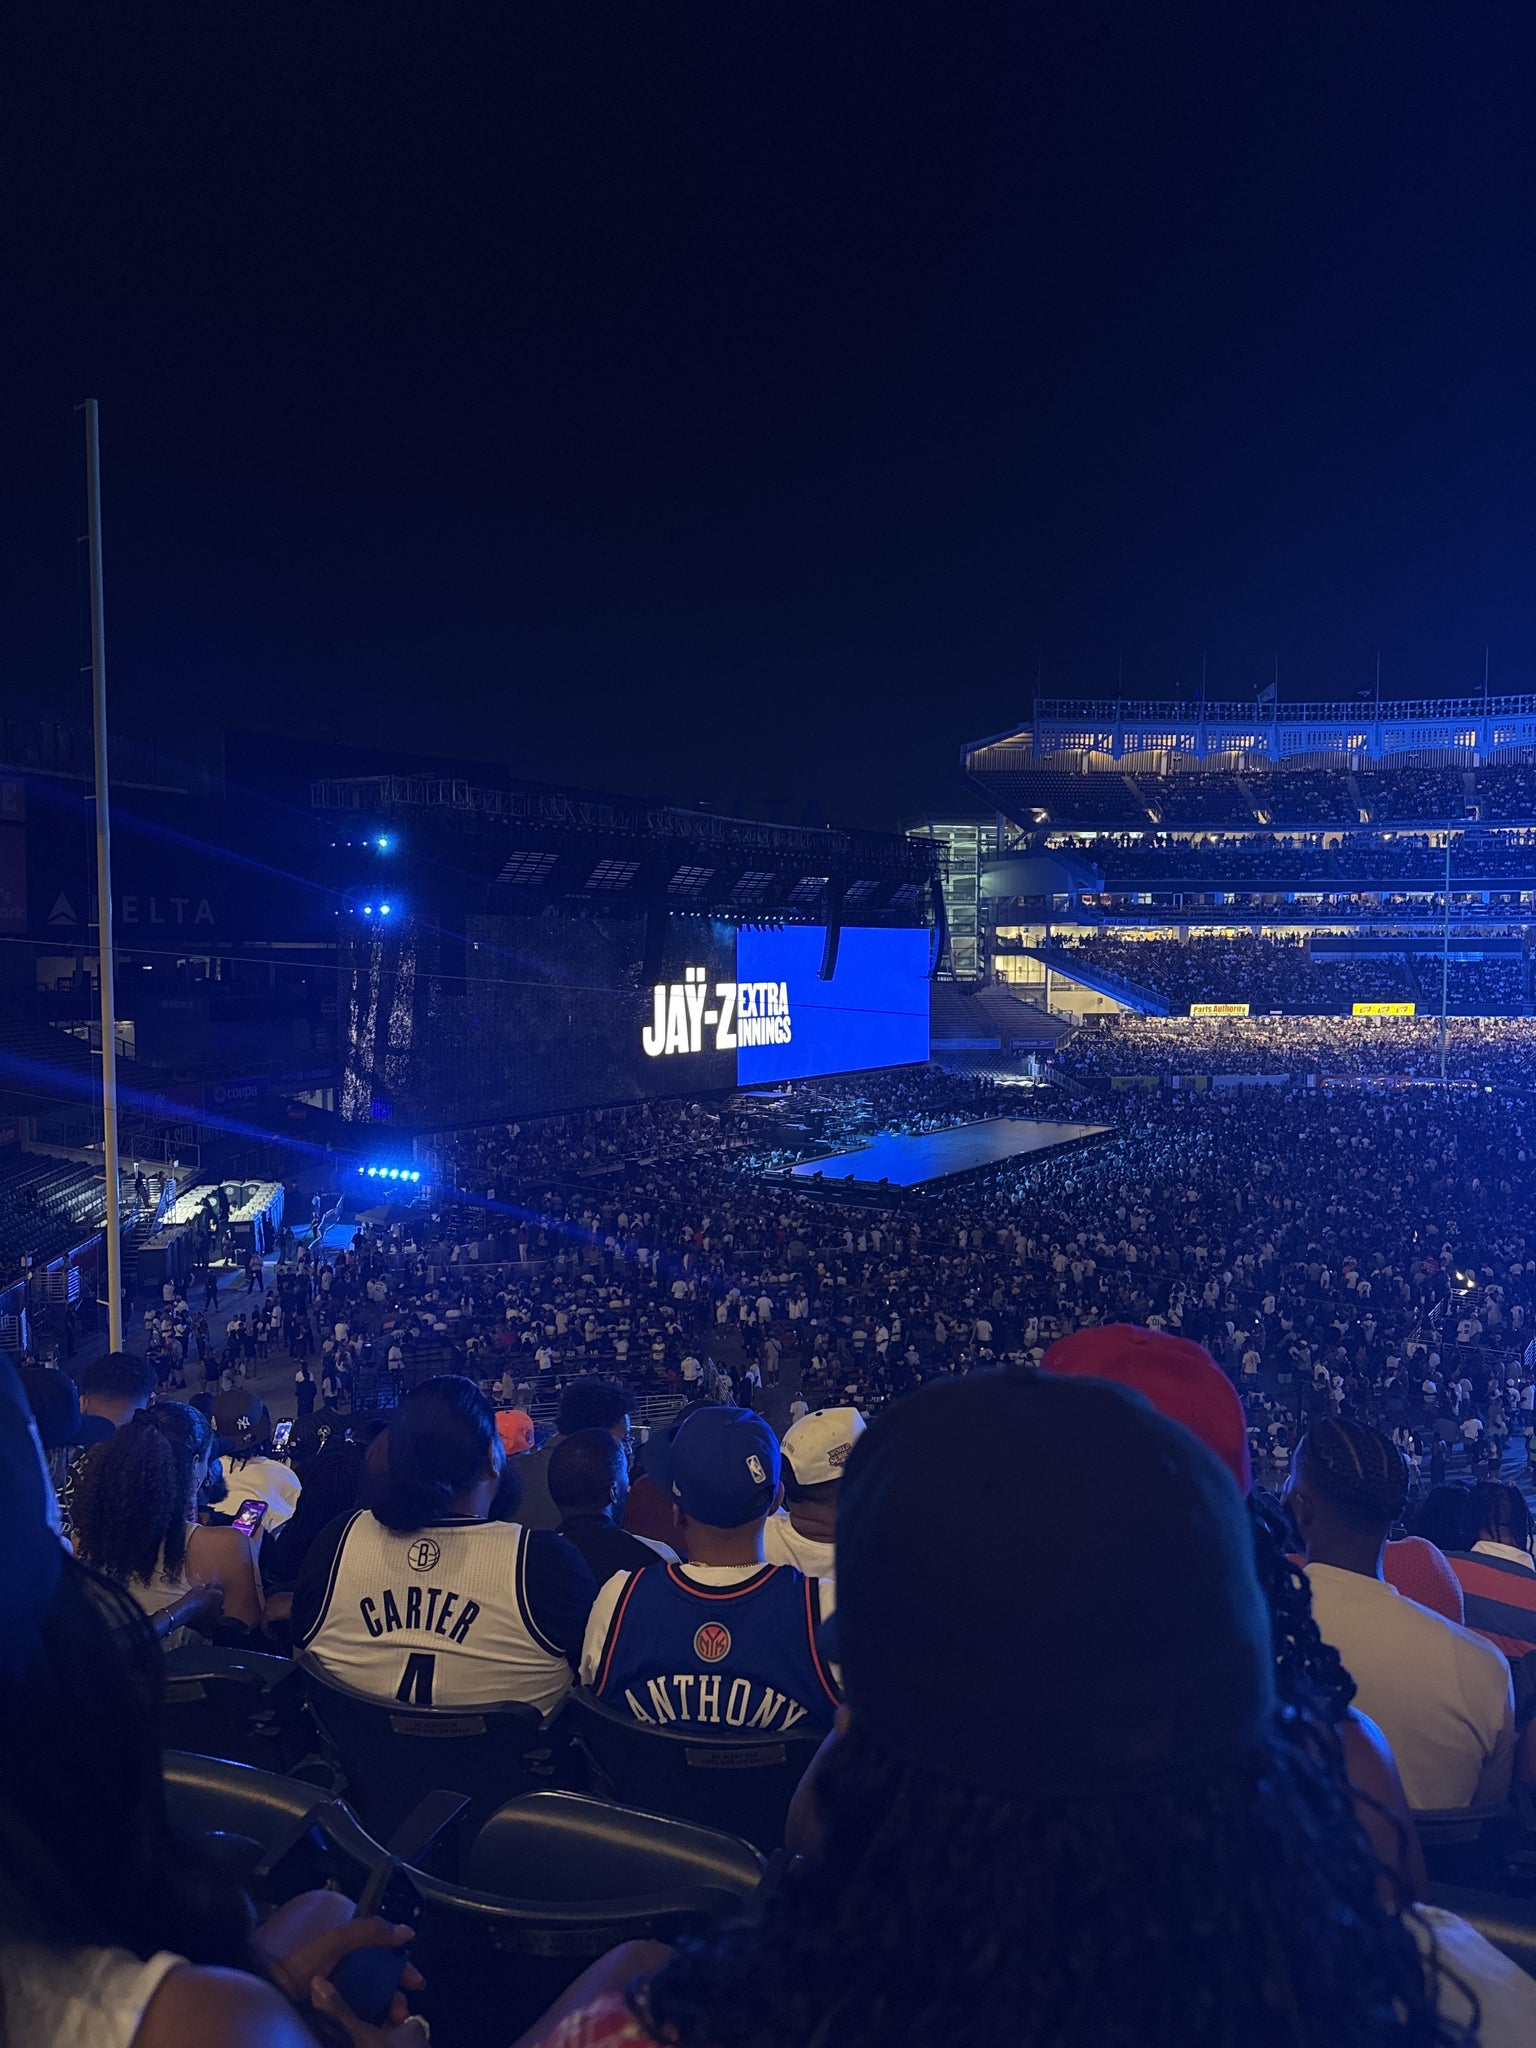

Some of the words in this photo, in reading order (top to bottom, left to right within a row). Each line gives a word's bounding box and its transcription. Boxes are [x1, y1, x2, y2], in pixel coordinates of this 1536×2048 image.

[92, 894, 216, 925] ELTA
[737, 982, 789, 1017] EXTRA
[1213, 1004, 1246, 1013] Authority
[737, 1015, 792, 1047] INNINGS
[359, 1586, 481, 1645] CARTER
[624, 1674, 808, 1732] ANTHONY
